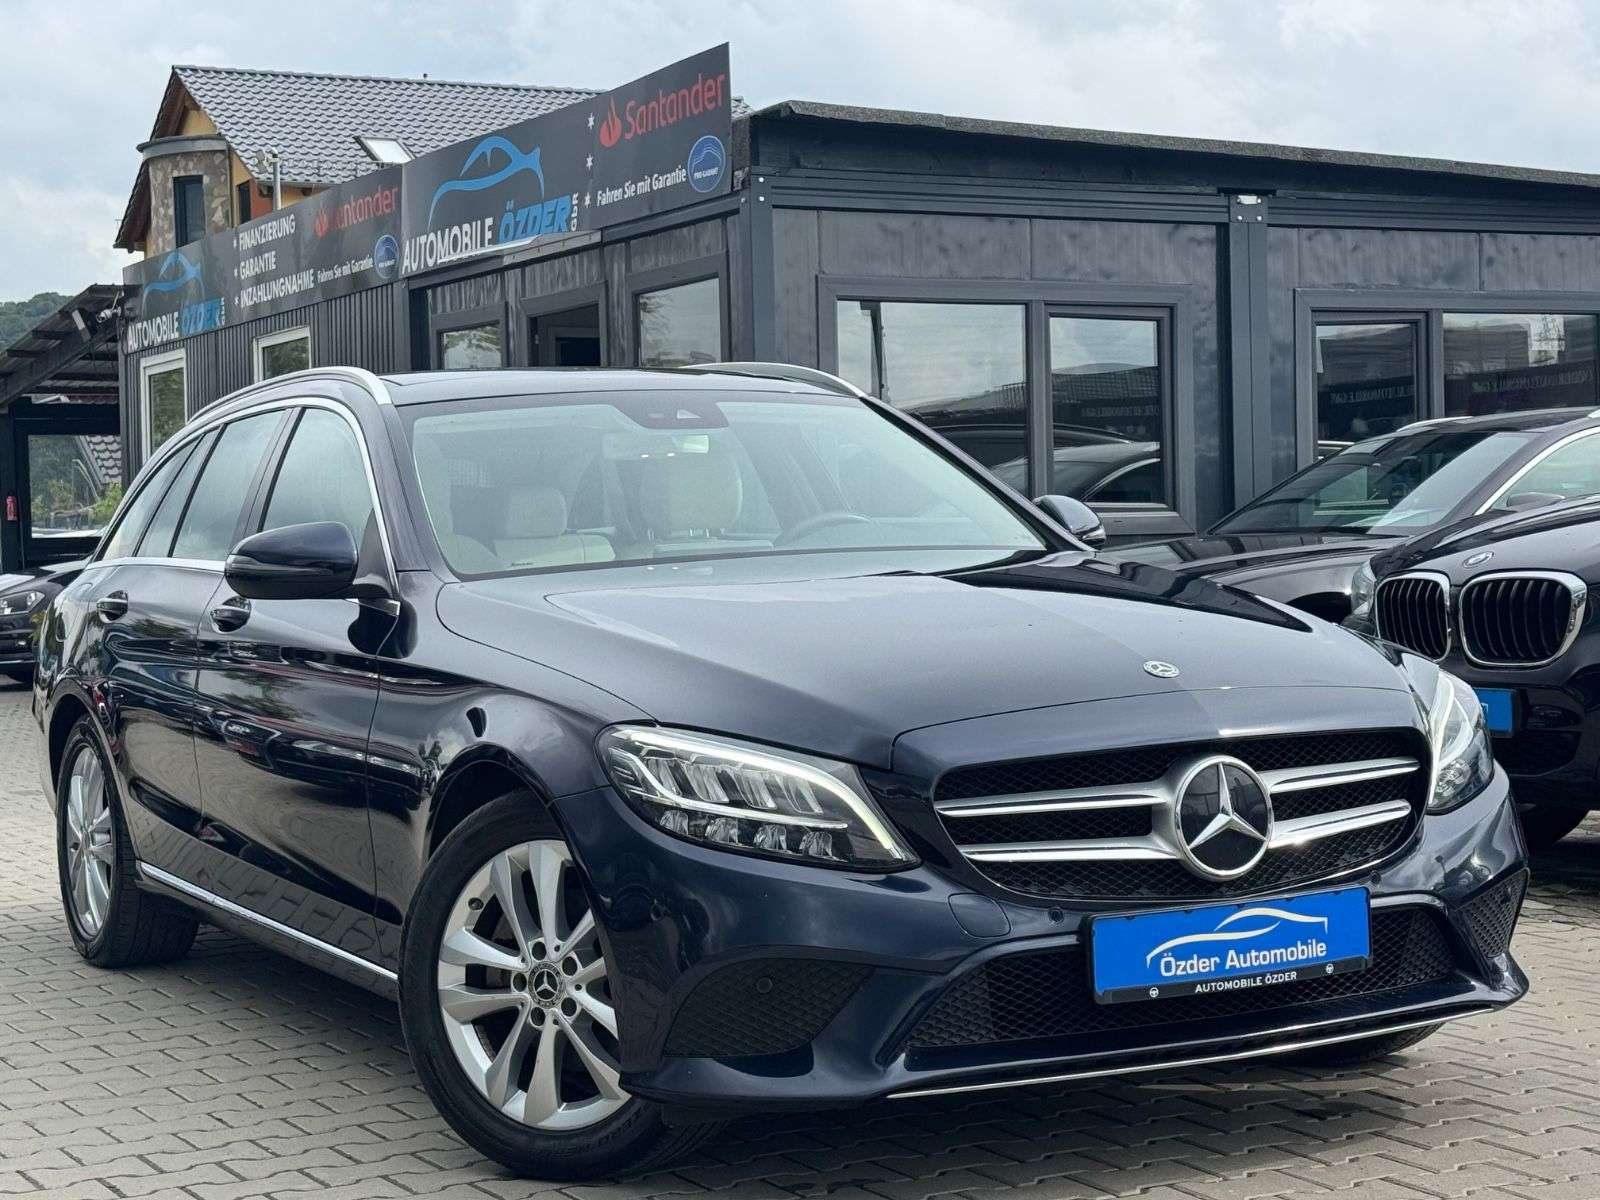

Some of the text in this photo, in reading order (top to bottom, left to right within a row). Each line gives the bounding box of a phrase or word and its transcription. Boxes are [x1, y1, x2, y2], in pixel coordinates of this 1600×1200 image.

[625, 73, 725, 141] Santander
[597, 164, 686, 207] Fahren Sie mit Garantie
[239, 214, 296, 252] FINANZIERUNG
[402, 195, 571, 274] AUTOMOBILE ÖZDER
[239, 250, 276, 281] GARANTIE
[240, 268, 314, 309] INZAHLUNGNAHME
[127, 311, 179, 353] AUTOMOBILE
[1160, 938, 1327, 977] Özder Automobile
[1195, 970, 1297, 994] AUTOMOBILE ÖZDER
